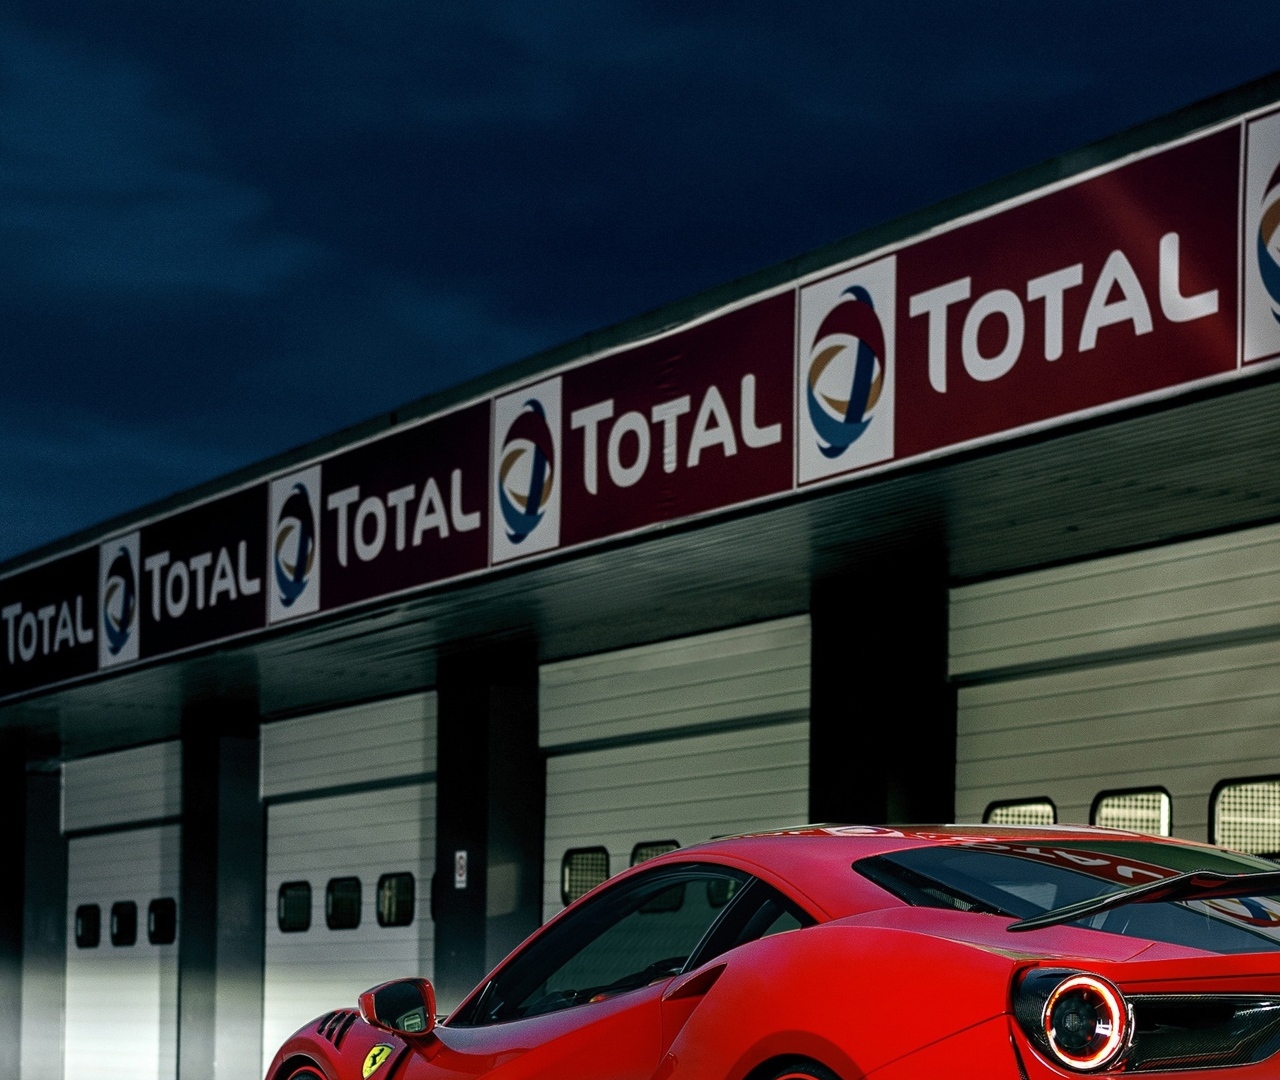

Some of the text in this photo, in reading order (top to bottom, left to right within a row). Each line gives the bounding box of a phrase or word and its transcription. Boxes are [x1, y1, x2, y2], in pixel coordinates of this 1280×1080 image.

[908, 231, 1220, 394] TOTAL
[570, 373, 782, 496] TOTAL
[327, 468, 481, 568] TOTAL
[1, 595, 94, 664] TOTAL
[144, 540, 261, 622] TOTAL
